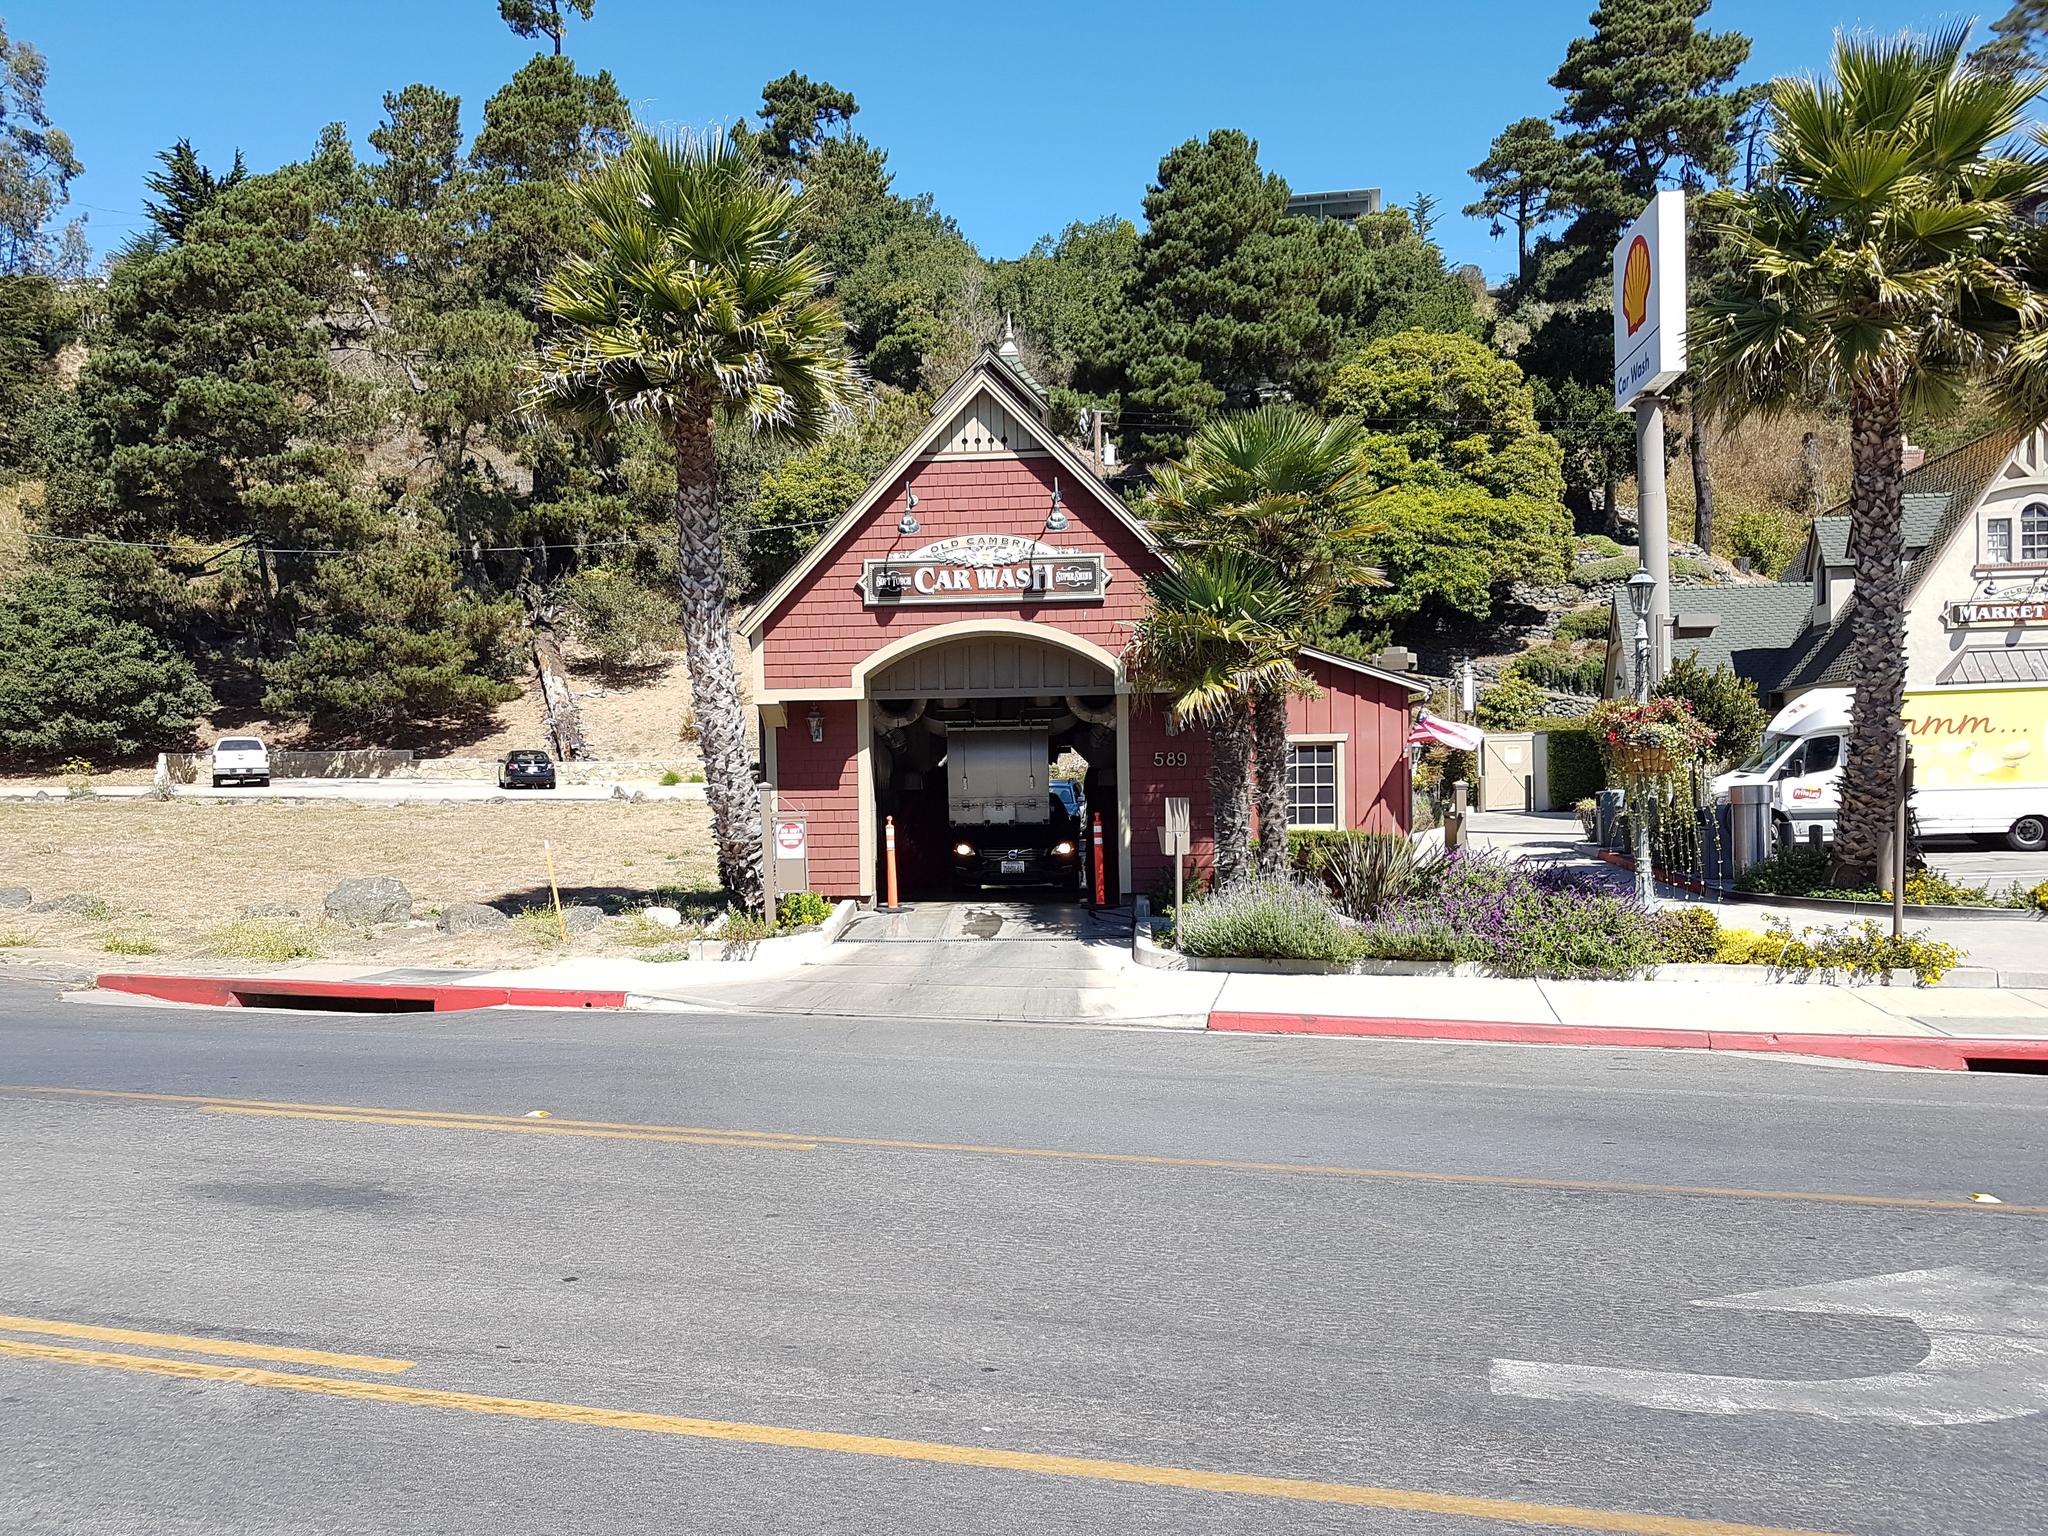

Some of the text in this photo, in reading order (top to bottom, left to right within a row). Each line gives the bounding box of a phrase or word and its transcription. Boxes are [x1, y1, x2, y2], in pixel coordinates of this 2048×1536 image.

[1618, 351, 1650, 395] Car Wash
[930, 540, 959, 553] OLD
[966, 536, 1036, 552] CAMBRIA
[914, 564, 1055, 595] CAR WASH
[1958, 605, 2047, 622] MARKET
[1153, 751, 1187, 767] 589
